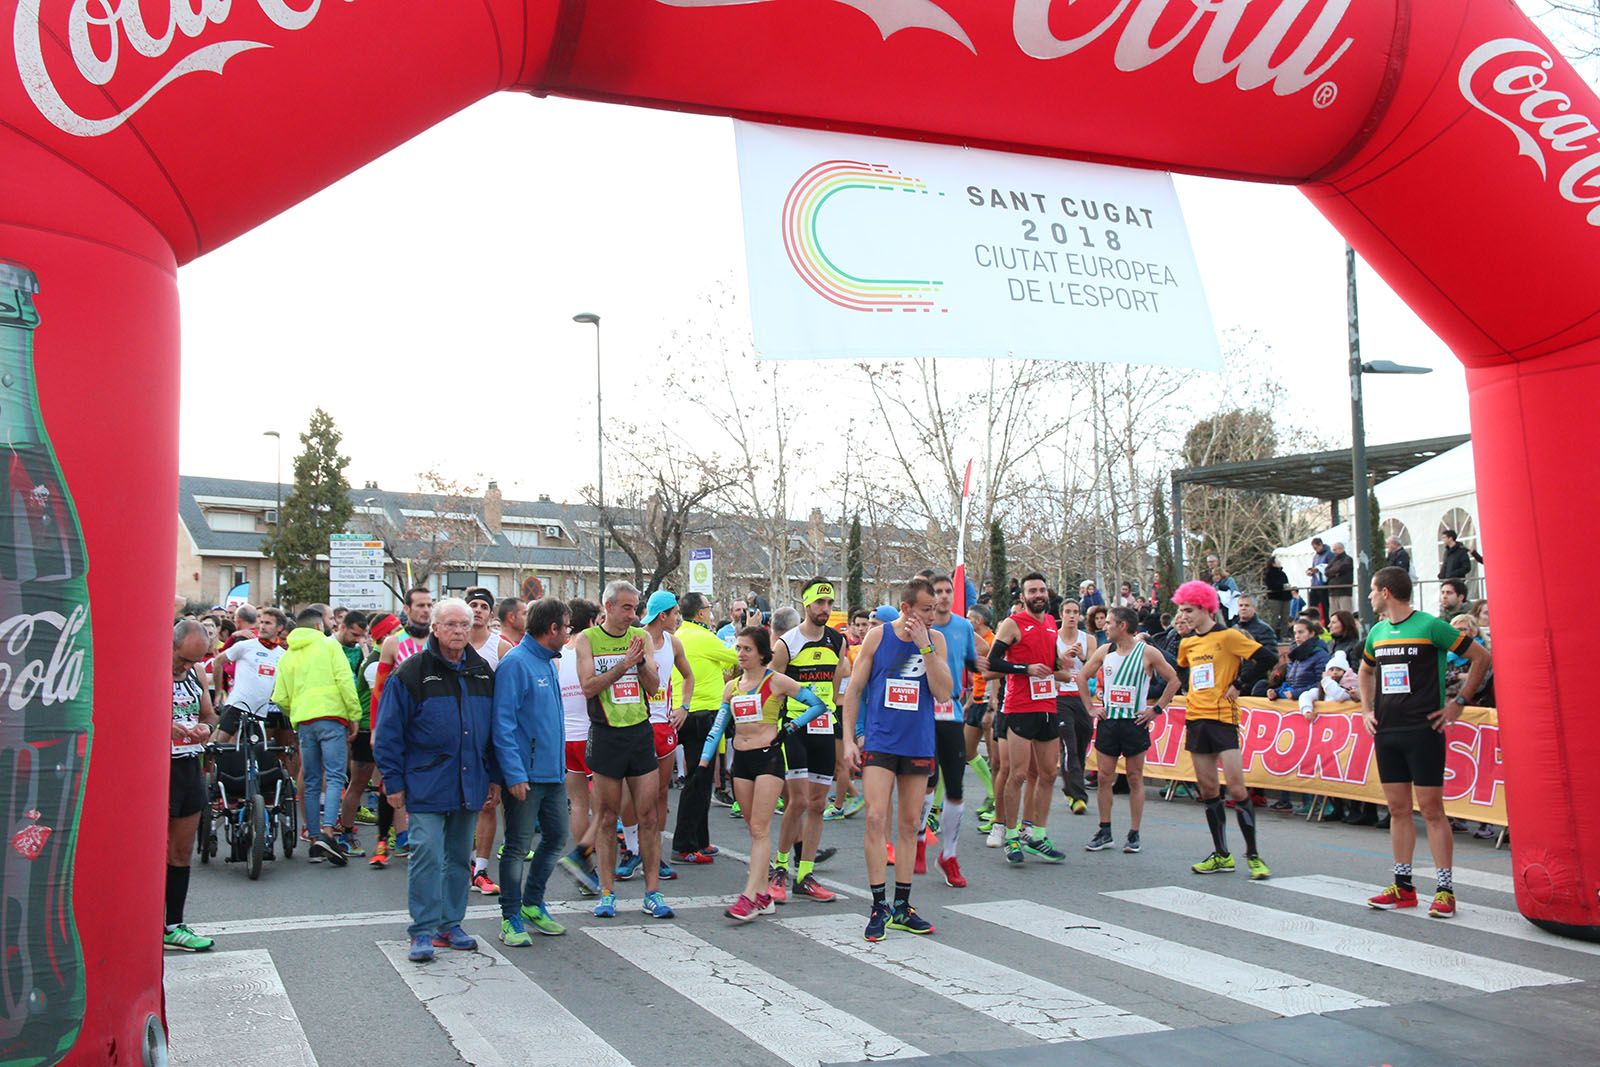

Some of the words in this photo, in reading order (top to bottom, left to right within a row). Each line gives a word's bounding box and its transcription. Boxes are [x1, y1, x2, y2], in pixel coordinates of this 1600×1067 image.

[966, 185, 1046, 213] SANT
[1061, 197, 1153, 229] CUGAT
[1021, 219, 1121, 251] 2018
[974, 244, 1058, 273] CIUTAT
[1066, 252, 1179, 288] EUROPEA
[1007, 278, 1044, 303] DE
[1049, 281, 1159, 313] L'ESPORT
[1407, 647, 1418, 655] CH
[891, 687, 915, 695] XAVIER
[897, 694, 908, 702] 31
